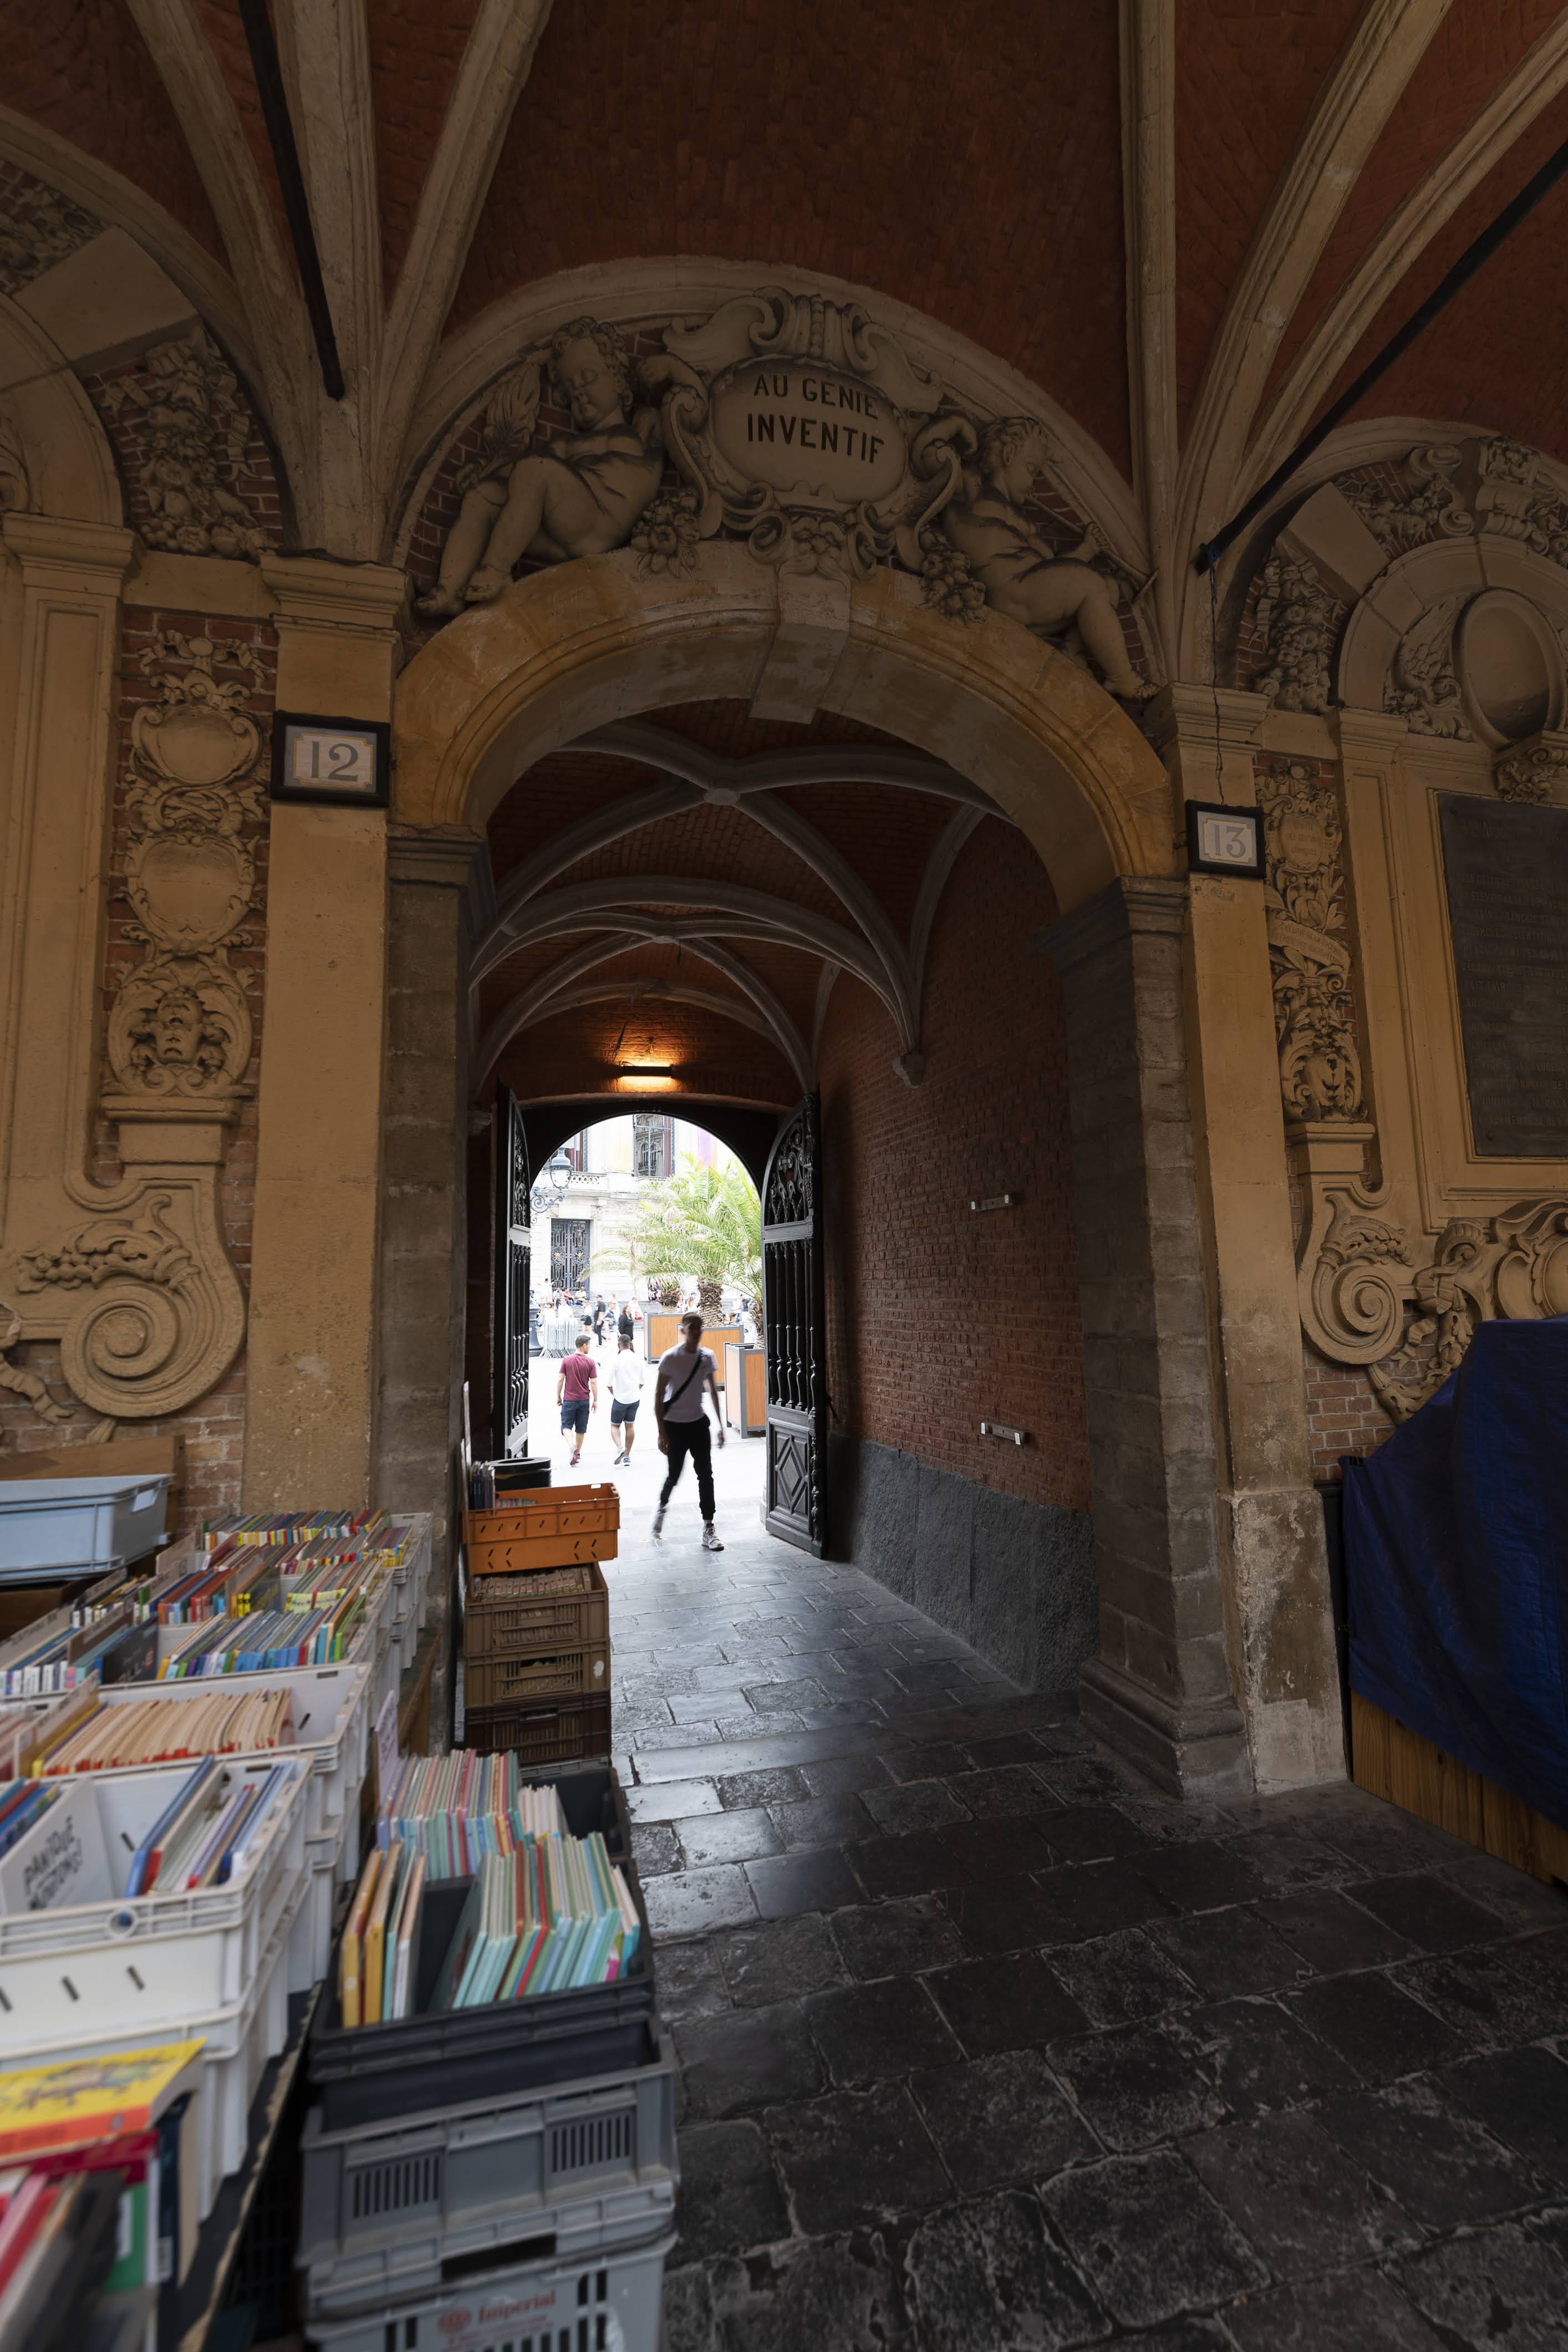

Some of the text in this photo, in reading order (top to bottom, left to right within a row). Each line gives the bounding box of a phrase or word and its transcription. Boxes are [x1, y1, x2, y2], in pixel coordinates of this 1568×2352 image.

[754, 374, 788, 398] AU
[747, 413, 885, 464] INVENTIF
[310, 741, 359, 782] 12
[1214, 824, 1246, 858] 13
